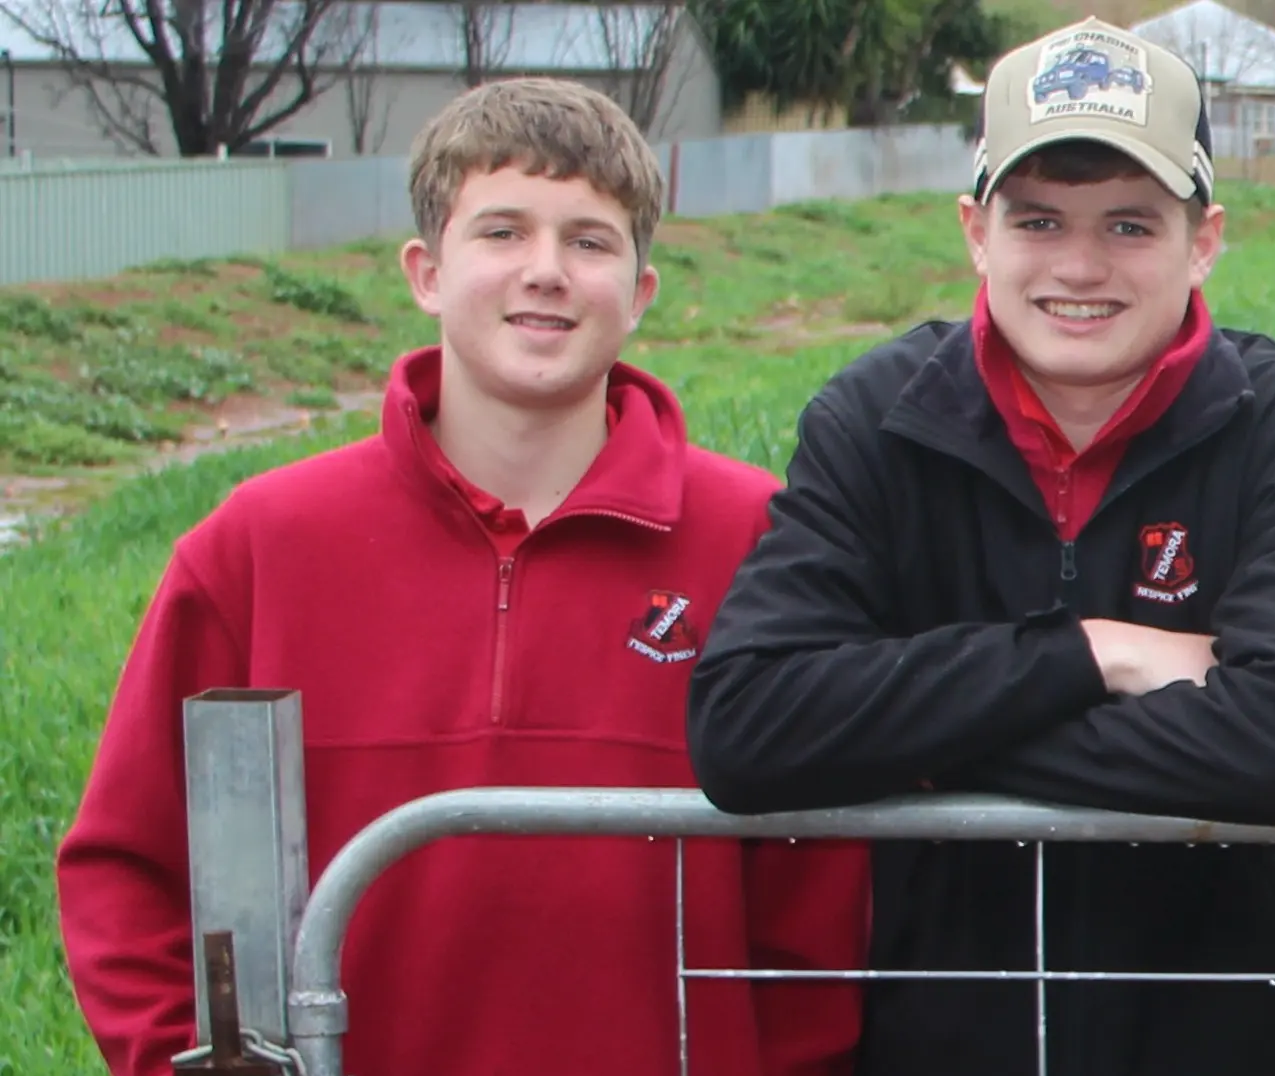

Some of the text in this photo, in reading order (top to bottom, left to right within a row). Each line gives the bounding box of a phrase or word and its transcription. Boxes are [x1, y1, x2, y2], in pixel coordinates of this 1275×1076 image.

[1045, 102, 1134, 118] AUSTRALIA
[1153, 529, 1186, 580] TEMORA
[650, 596, 691, 640] TEMORA
